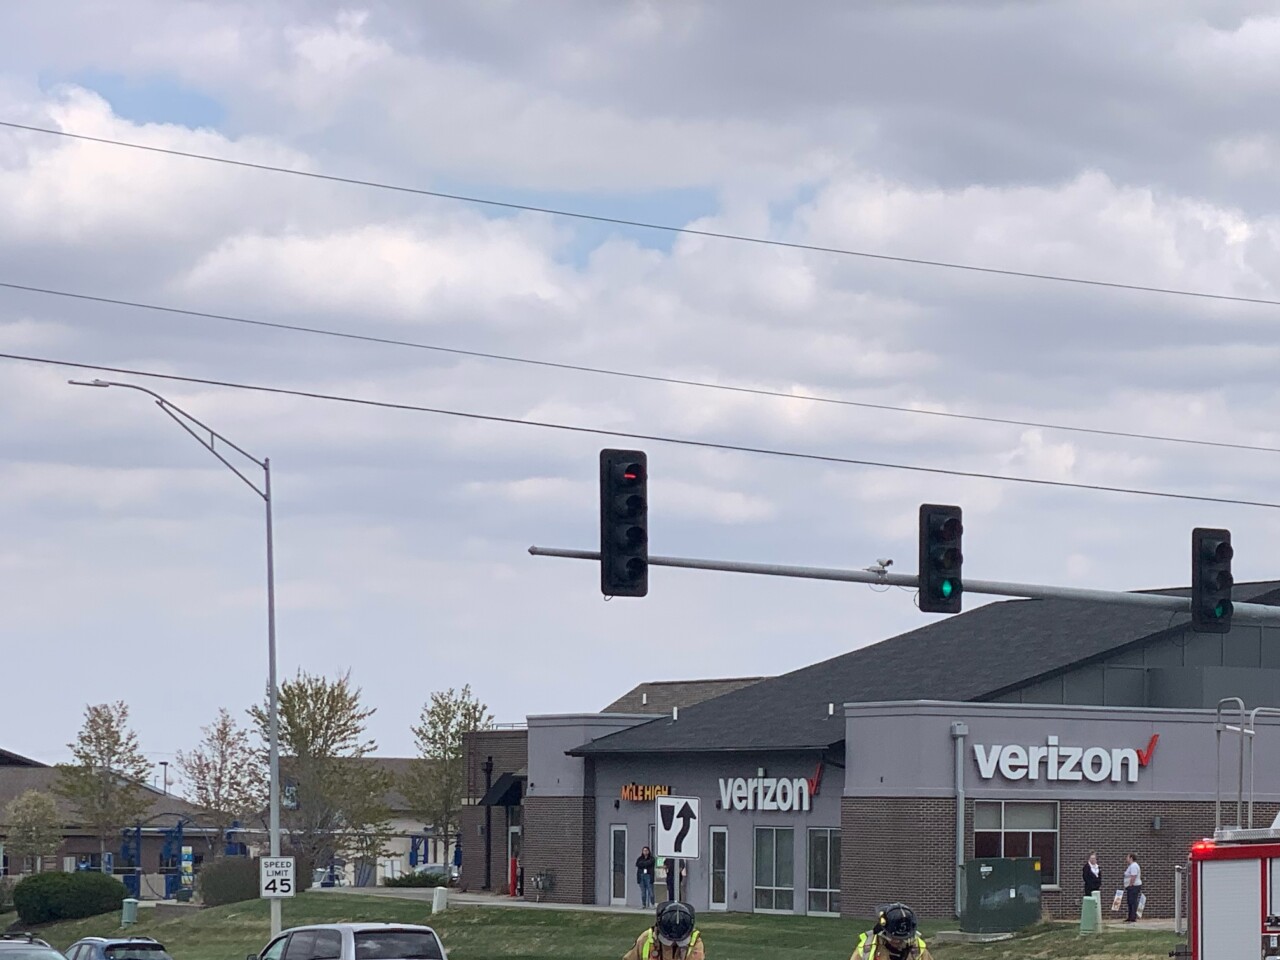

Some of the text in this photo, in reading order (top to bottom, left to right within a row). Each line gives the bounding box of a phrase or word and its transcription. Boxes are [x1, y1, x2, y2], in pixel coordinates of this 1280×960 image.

[973, 735, 1139, 783] verizon
[644, 784, 669, 801] HIGH
[719, 767, 810, 811] verizon
[263, 861, 292, 869] SPEED
[266, 869, 288, 877] LIMIT
[264, 878, 292, 894] 45
